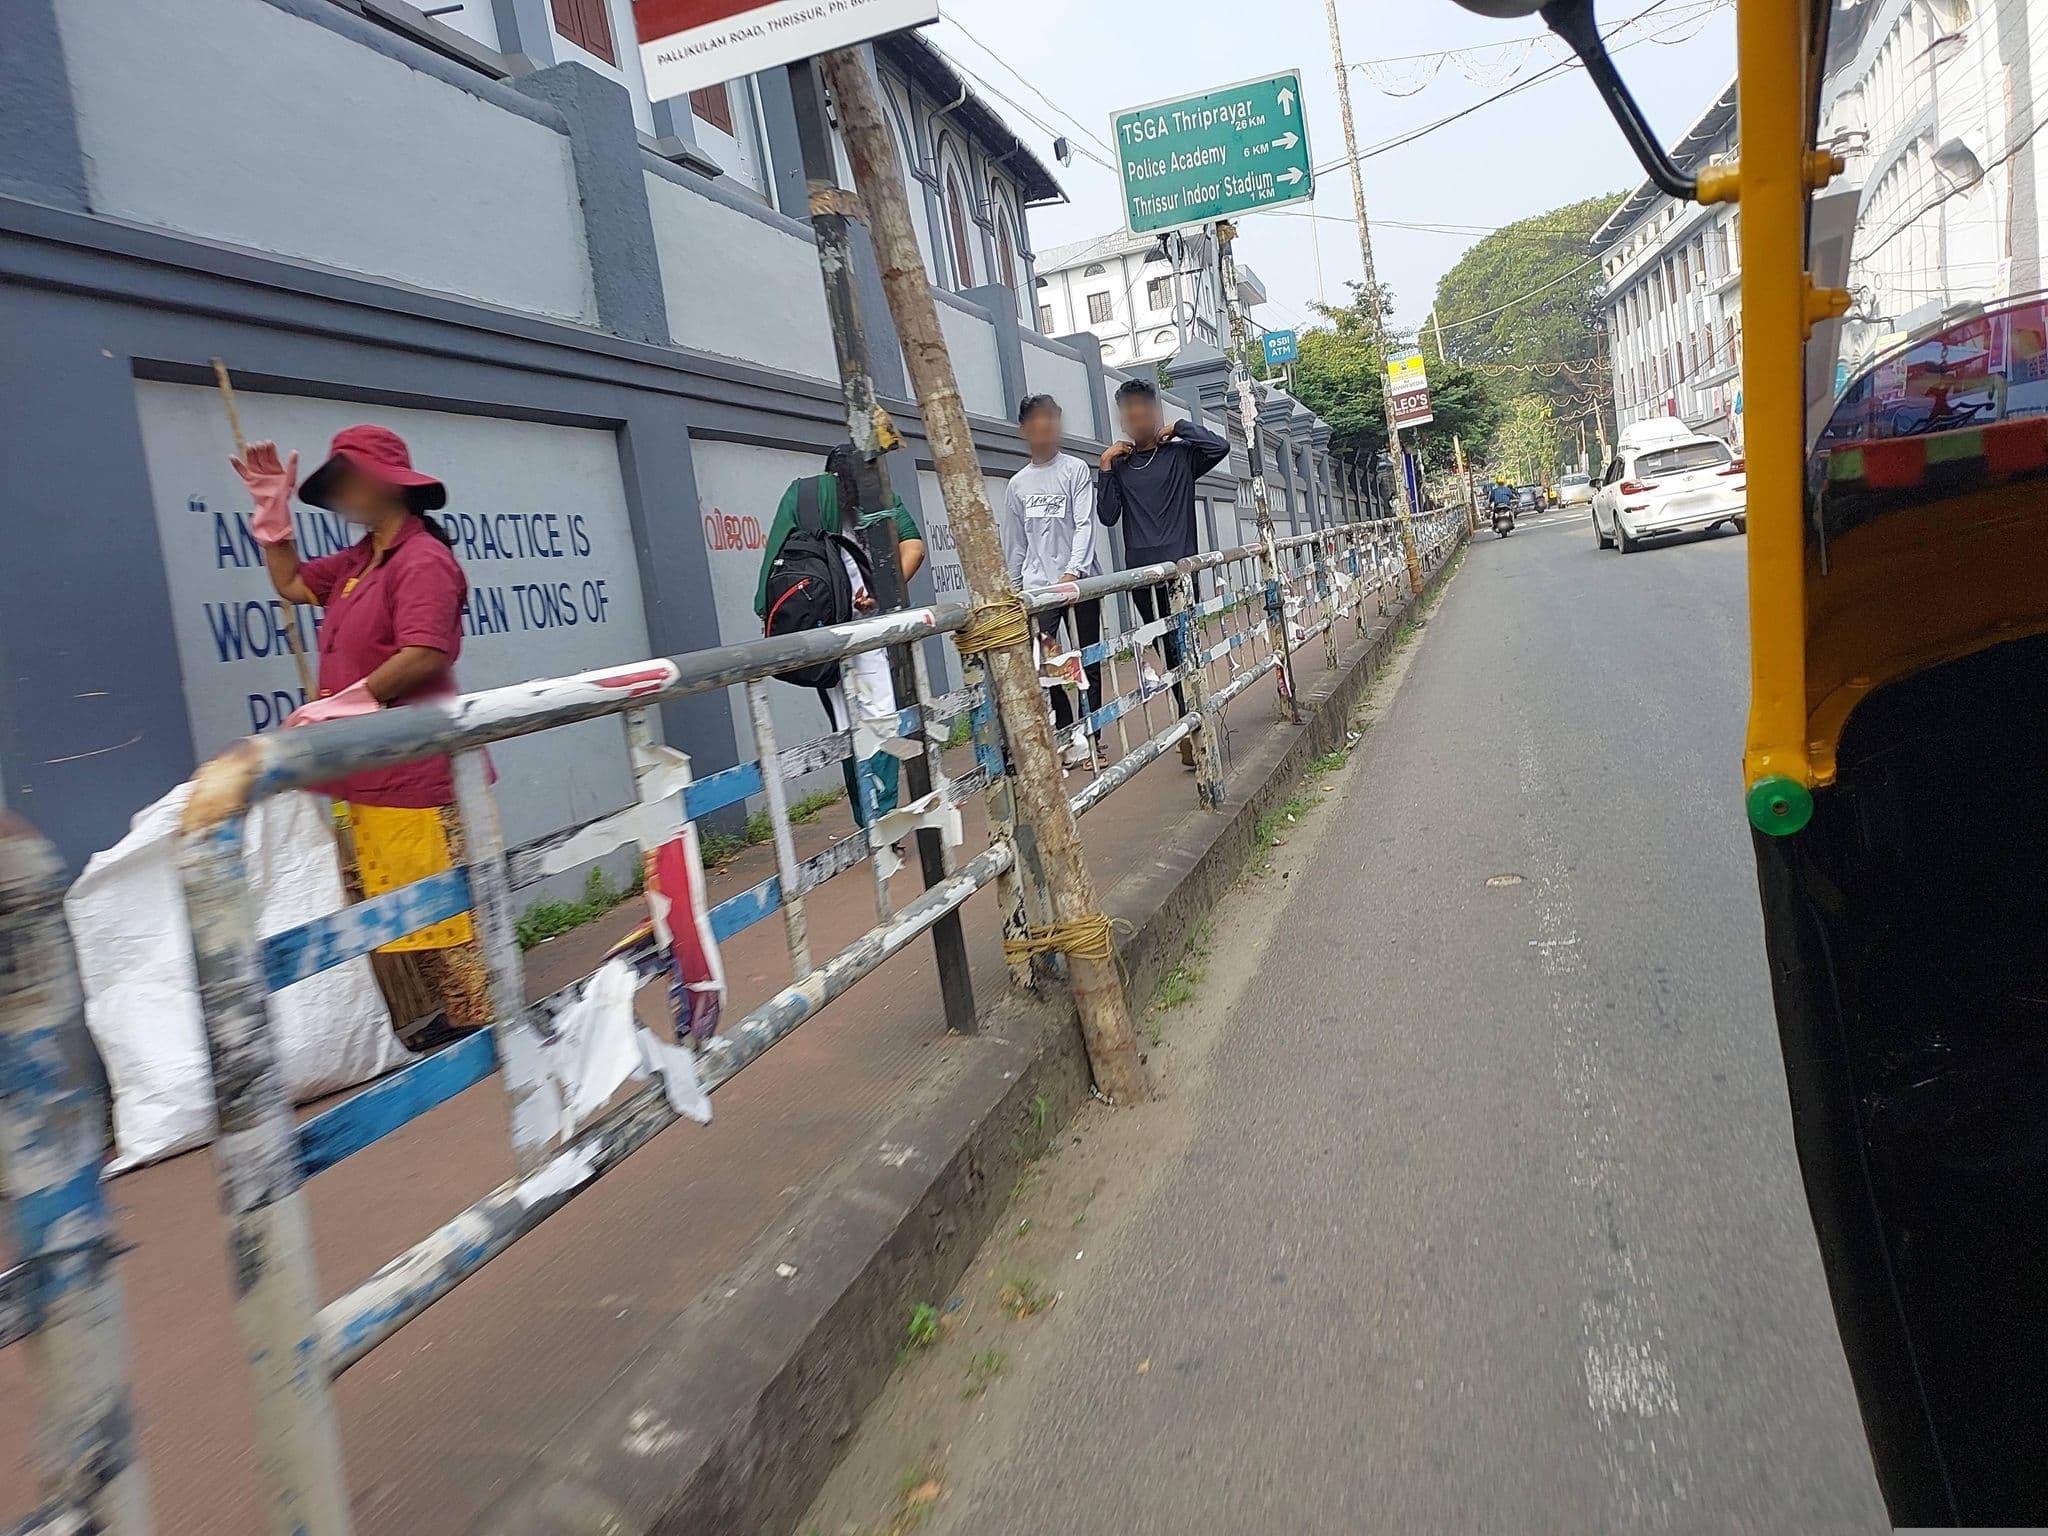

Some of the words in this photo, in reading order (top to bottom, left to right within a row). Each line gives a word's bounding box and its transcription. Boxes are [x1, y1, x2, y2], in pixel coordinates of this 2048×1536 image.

[767, 6, 827, 33] THRISSUR,
[1122, 117, 1169, 145] TSGA
[1172, 100, 1252, 133] Thriprayar
[1235, 119, 1247, 131] 26
[1248, 115, 1266, 129] KM
[1127, 159, 1167, 182] Police
[1170, 145, 1226, 172] Academy
[1243, 147, 1250, 157] 6
[1252, 143, 1269, 155] KM
[1133, 195, 1179, 218] Thrissur
[1182, 182, 1221, 206] Indoor
[1223, 172, 1273, 197] Stadium
[1258, 188, 1275, 200] KM
[1271, 345, 1291, 357] ATM
[1237, 370, 1249, 382] 10
[1394, 393, 1428, 412] LEO'S
[443, 513, 564, 560] PRACTICE
[567, 514, 591, 557] IS
[512, 583, 577, 630] TONS
[582, 580, 609, 623] OF
